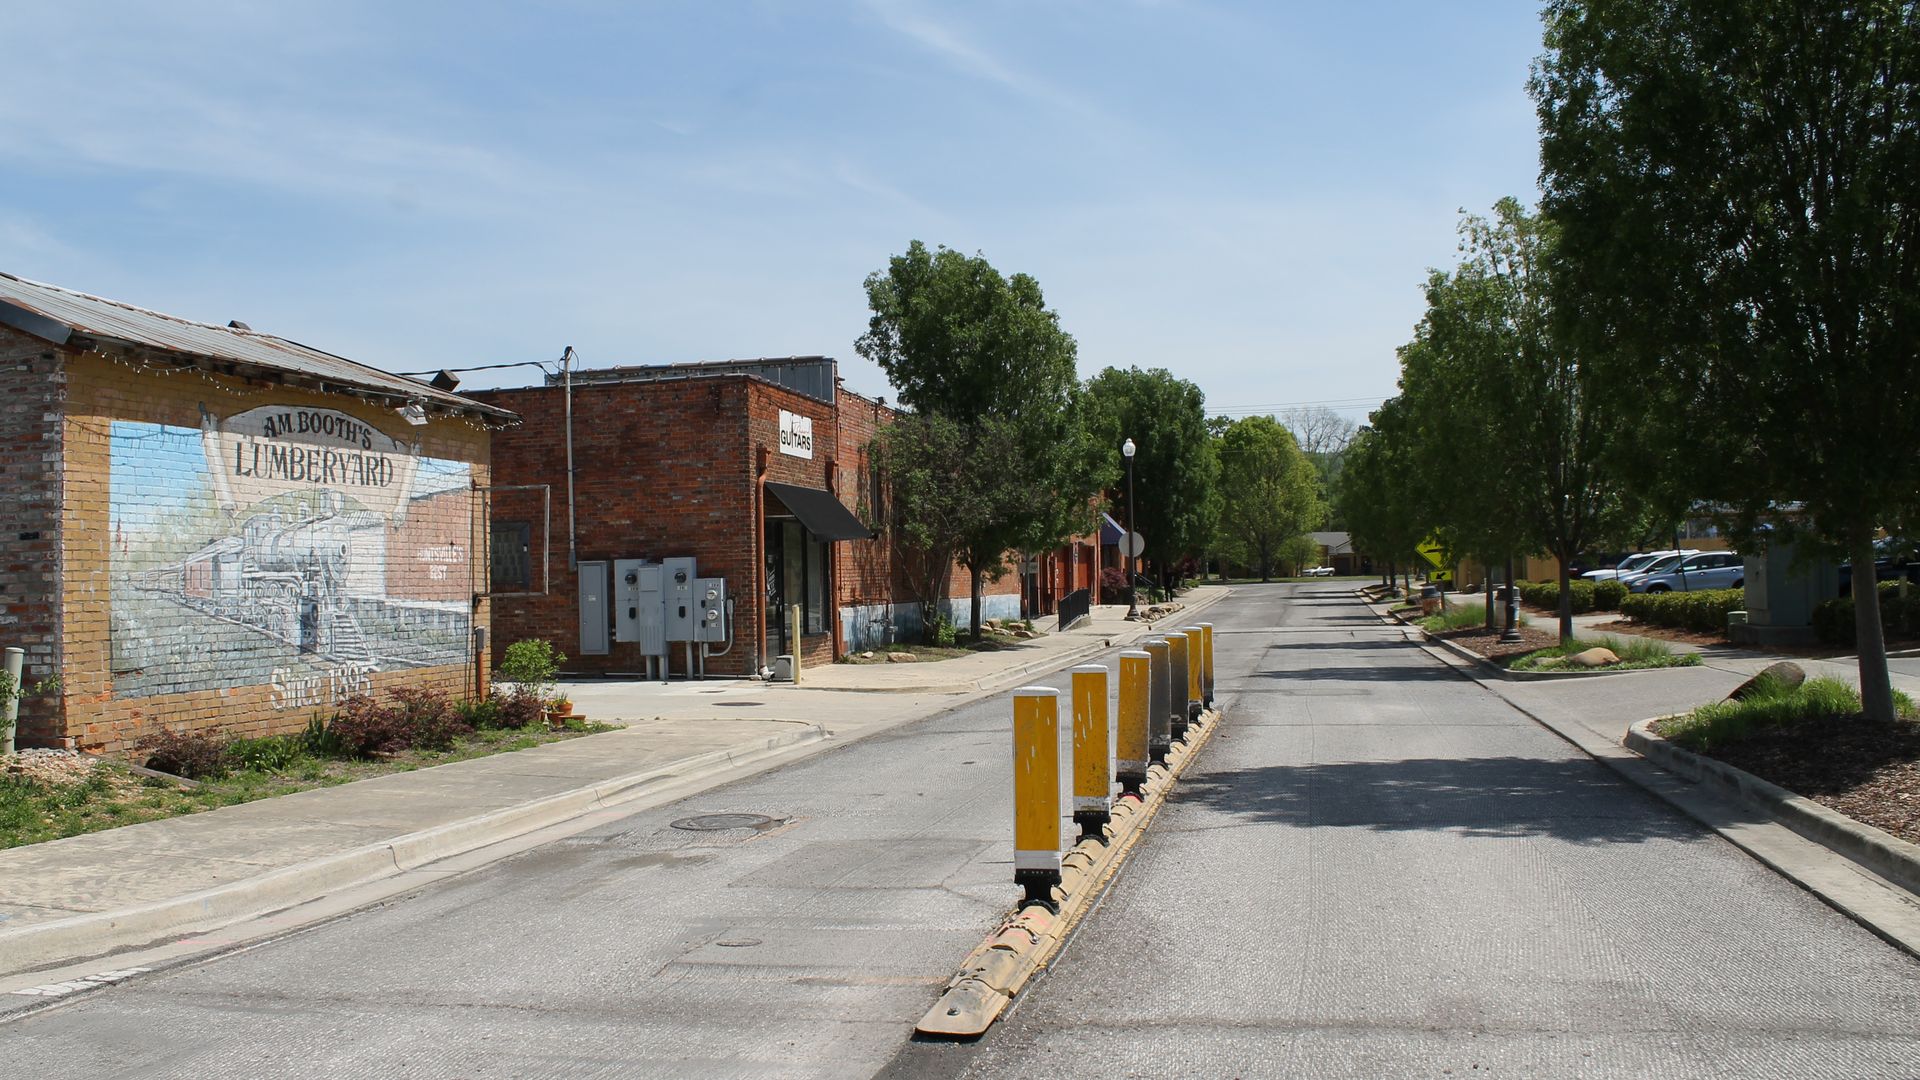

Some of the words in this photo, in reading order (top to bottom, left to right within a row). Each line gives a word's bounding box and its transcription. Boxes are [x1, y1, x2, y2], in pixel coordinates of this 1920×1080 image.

[298, 411, 372, 450] BOOTH'S
[780, 429, 811, 451] GUITARS
[235, 442, 394, 488] LUMBERYARD
[270, 666, 321, 709] Since
